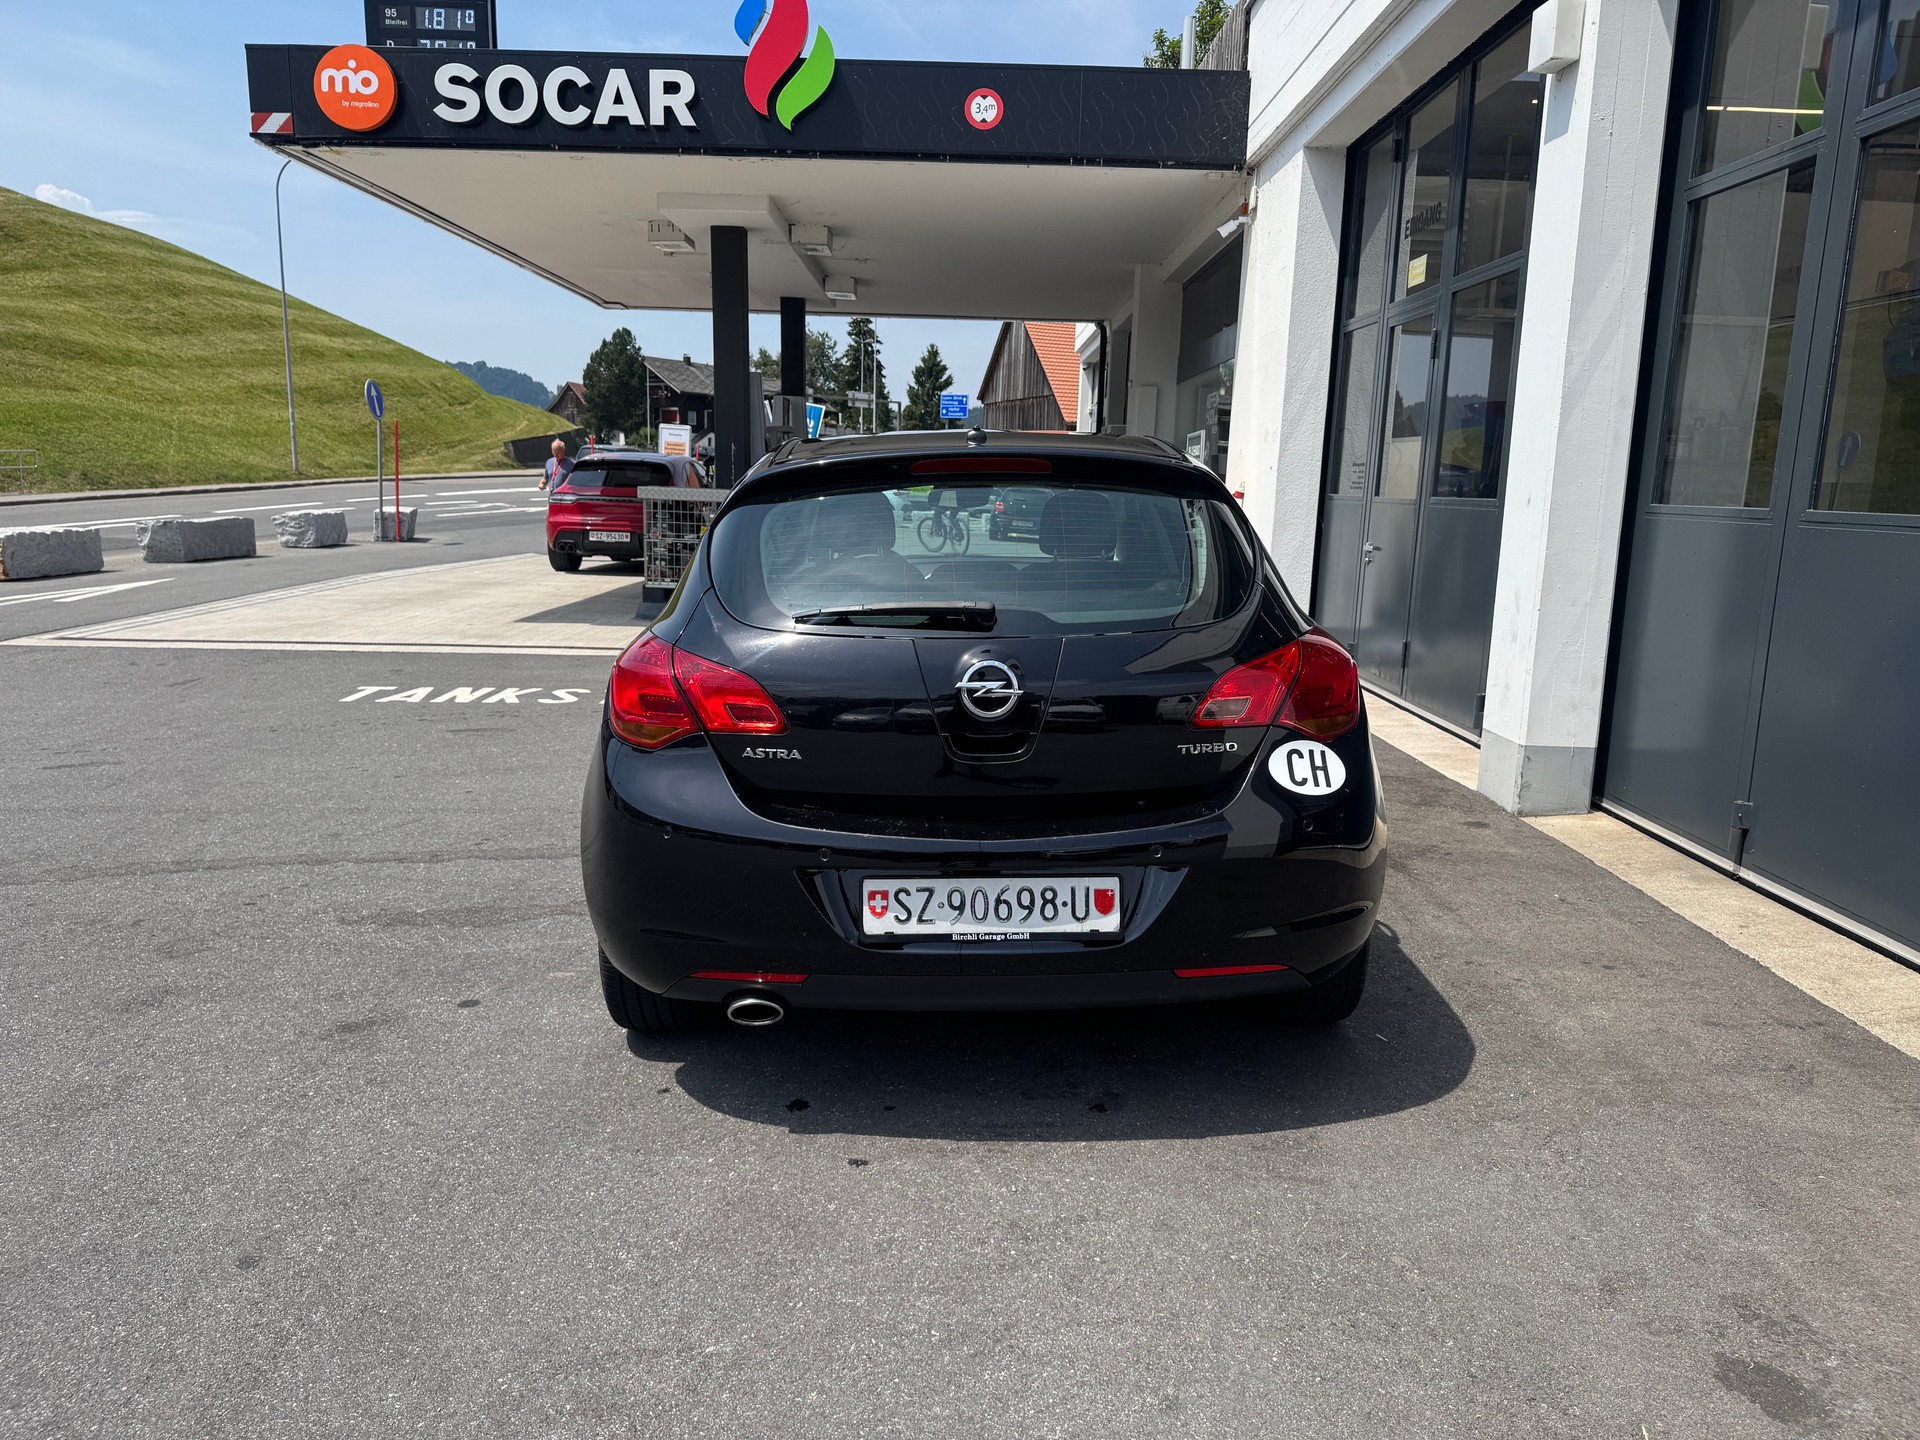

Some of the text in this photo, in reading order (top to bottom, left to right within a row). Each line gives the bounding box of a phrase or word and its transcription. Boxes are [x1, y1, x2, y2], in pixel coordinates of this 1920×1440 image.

[385, 8, 397, 17] 95
[321, 59, 379, 95] mio
[433, 62, 696, 127] SOCAR
[342, 99, 349, 108] by
[338, 686, 605, 704] TANKS
[742, 747, 802, 760] ASTRA
[1177, 742, 1238, 755] TURBO
[1286, 748, 1332, 788] CH
[952, 933, 978, 941] Birchli
[979, 933, 1005, 942] Garage
